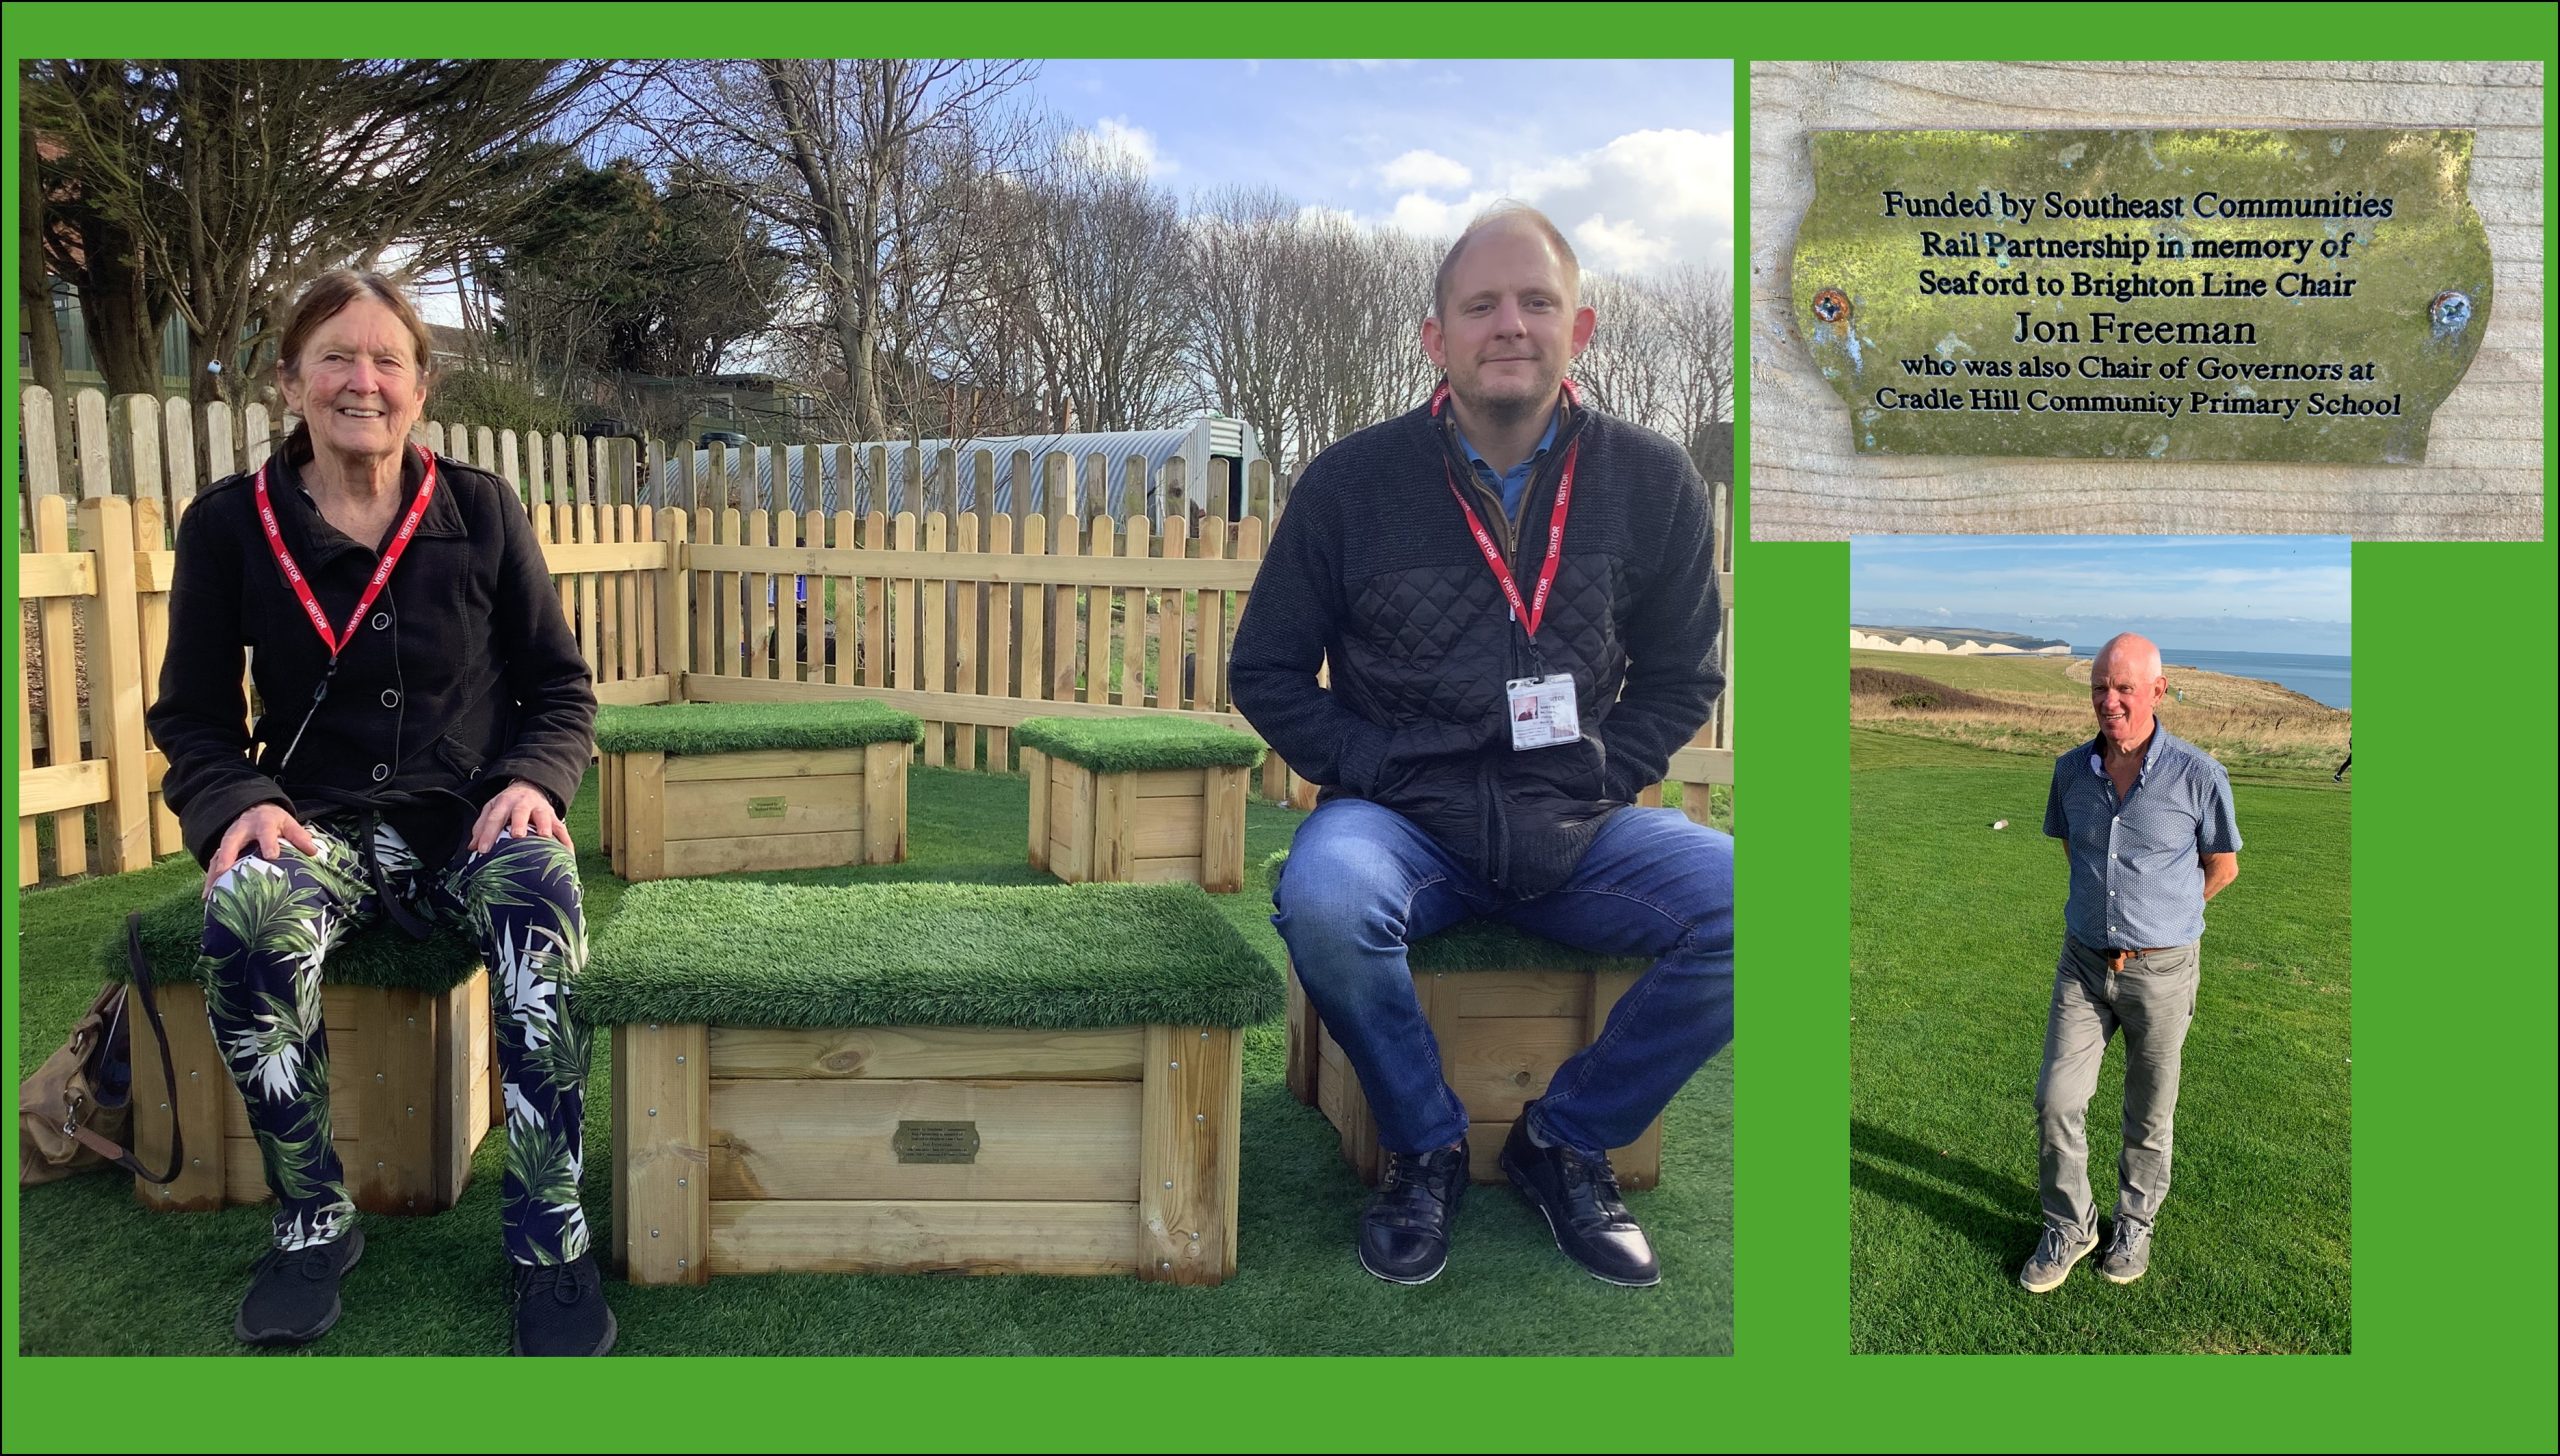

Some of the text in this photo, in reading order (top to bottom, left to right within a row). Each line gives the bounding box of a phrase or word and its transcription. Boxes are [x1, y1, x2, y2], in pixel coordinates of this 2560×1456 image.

[1882, 190, 2393, 225] Funded by Southeast Communities
[1920, 231, 2356, 266] Rail Partnership in memory of
[1919, 269, 2357, 303] Seaford to Brighton Line Chair
[2015, 311, 2257, 345] Jon Freeman
[1900, 353, 2375, 381] who was also Chair of Governors at
[1875, 387, 2401, 420] Cradle Hill Community Primary School
[1556, 473, 1569, 506] VISITOR
[262, 506, 278, 538] VISITOR
[399, 511, 419, 541] VISITOR
[1476, 528, 1498, 561] VISITOR
[1548, 524, 1561, 559] VISITOR
[279, 551, 300, 584] VISITOR
[372, 555, 395, 586] VISITOR
[1502, 575, 1521, 609] VISITOR
[1533, 577, 1549, 611] VISITOR
[305, 598, 328, 630] VISITOR
[346, 602, 368, 633] VISITOR
